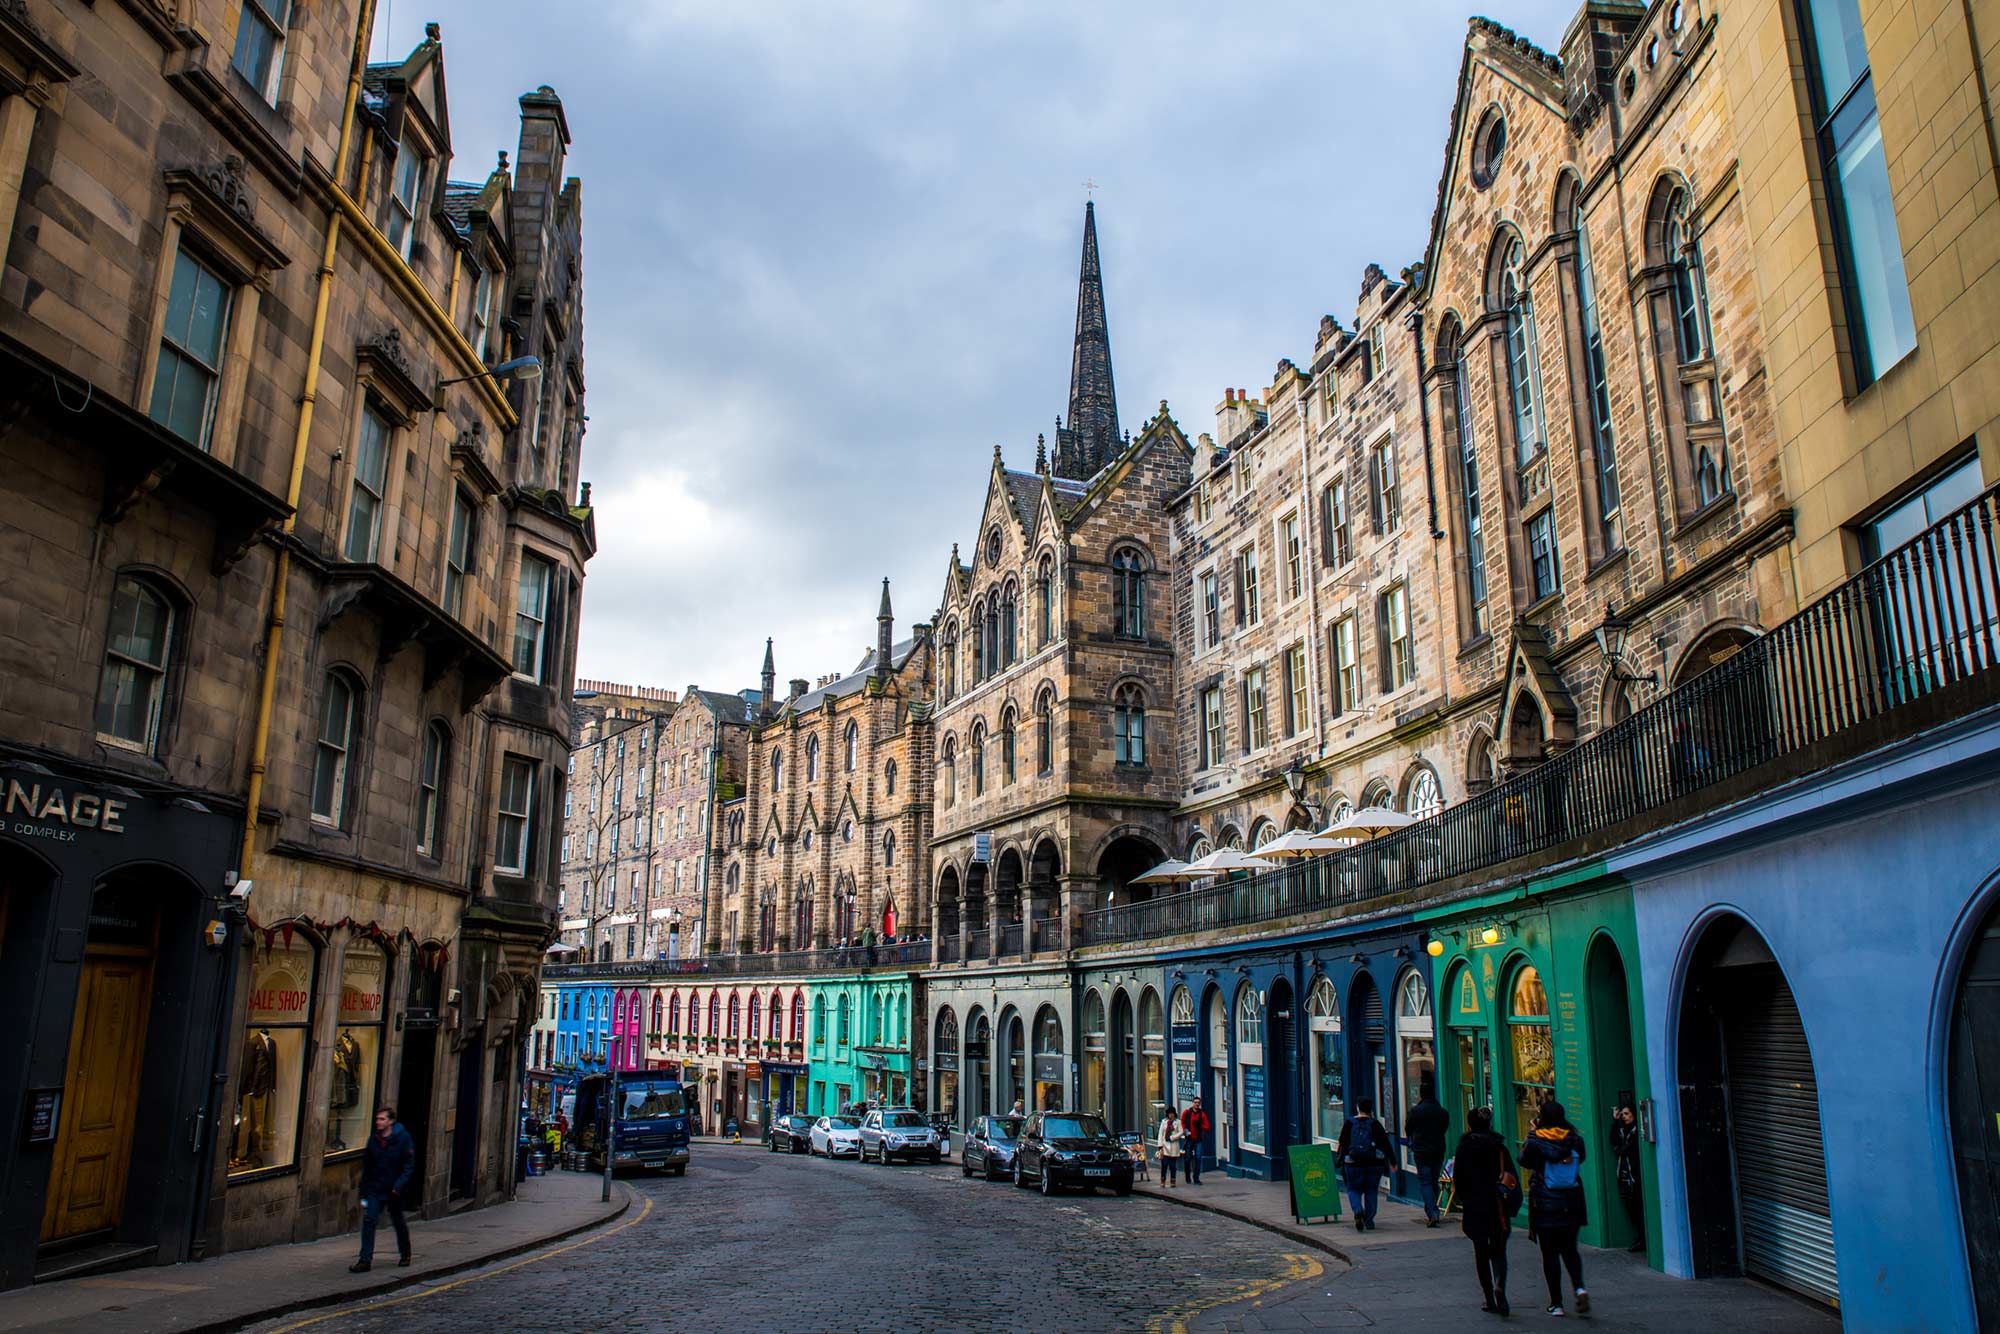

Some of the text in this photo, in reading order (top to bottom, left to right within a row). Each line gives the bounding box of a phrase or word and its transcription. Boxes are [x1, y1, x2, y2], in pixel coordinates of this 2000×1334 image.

[14, 823, 76, 841] COMPLEX
[278, 990, 307, 1011] SHOP
[340, 992, 381, 1011] ALE SHOP
